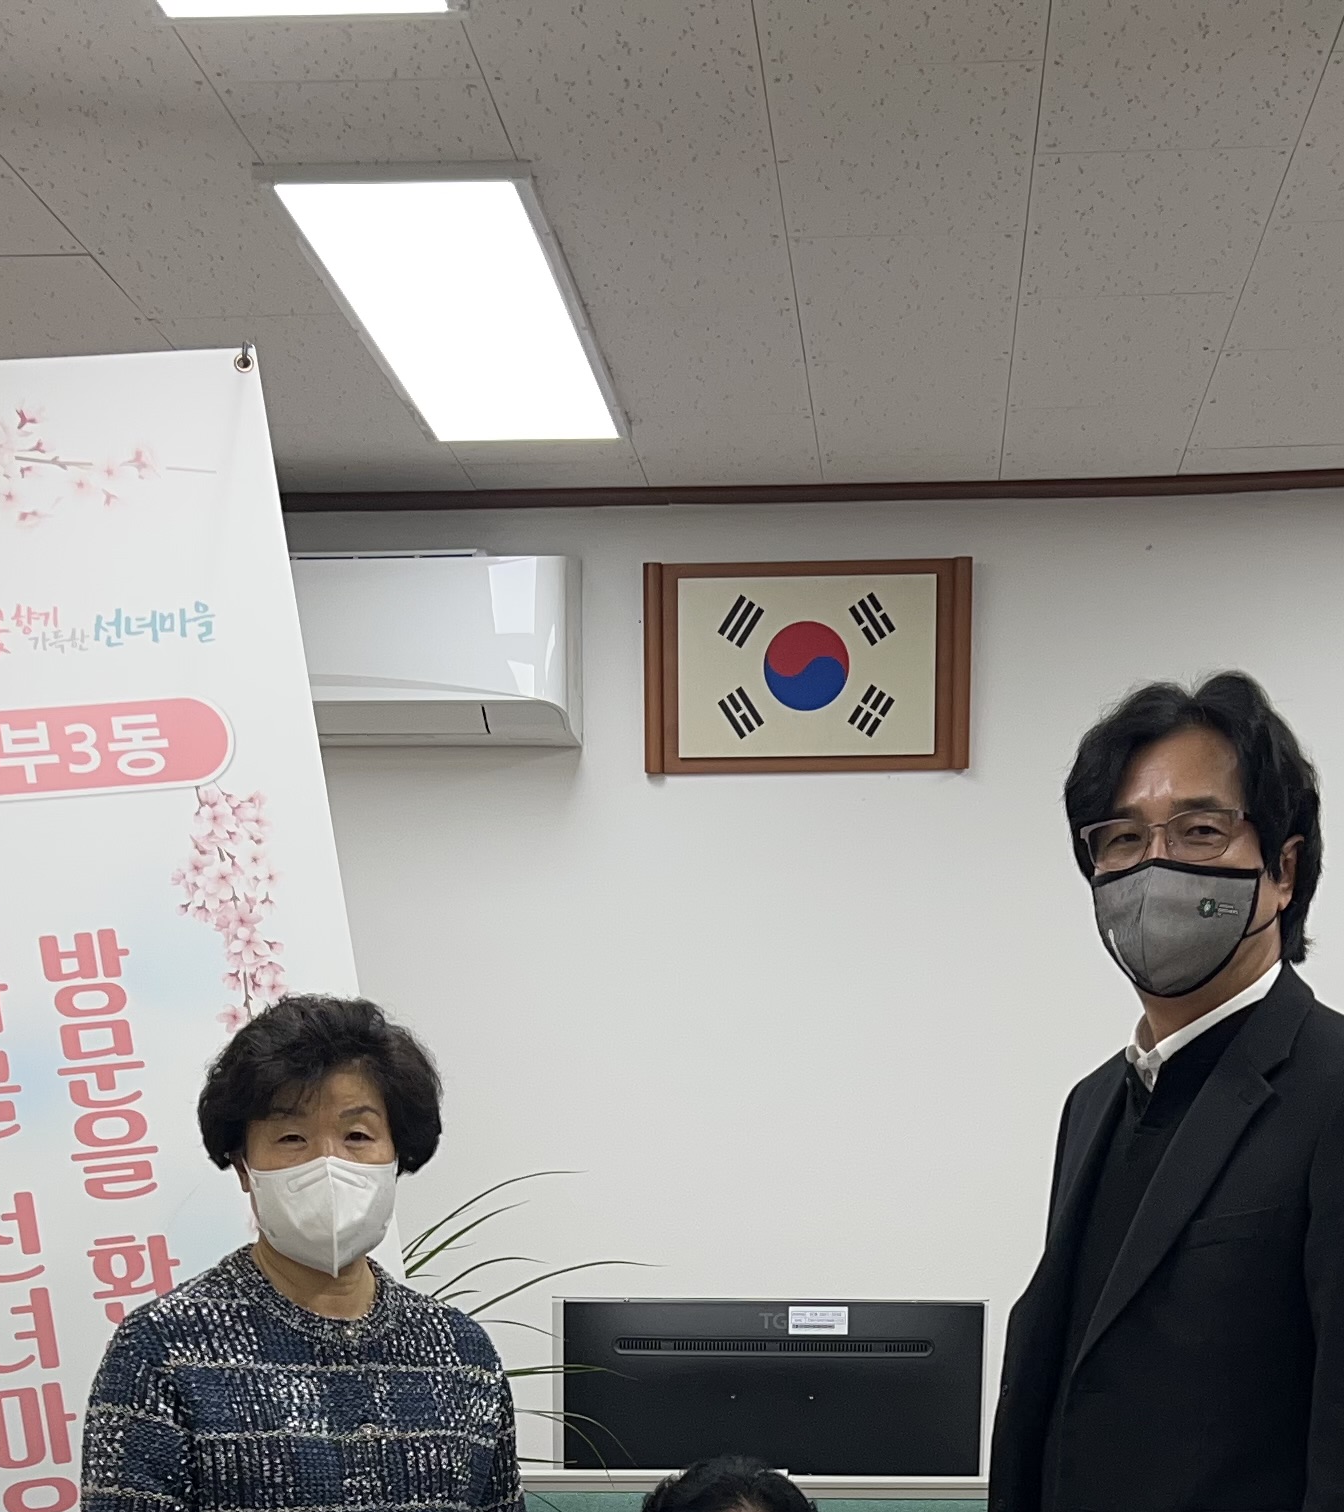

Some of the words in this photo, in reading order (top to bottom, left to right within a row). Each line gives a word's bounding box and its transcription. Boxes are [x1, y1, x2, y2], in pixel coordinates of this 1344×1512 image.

[11, 604, 60, 636] 향기
[94, 601, 217, 648] 선녀마을
[29, 629, 90, 654] 가득한
[38, 928, 159, 1201] 방문을
